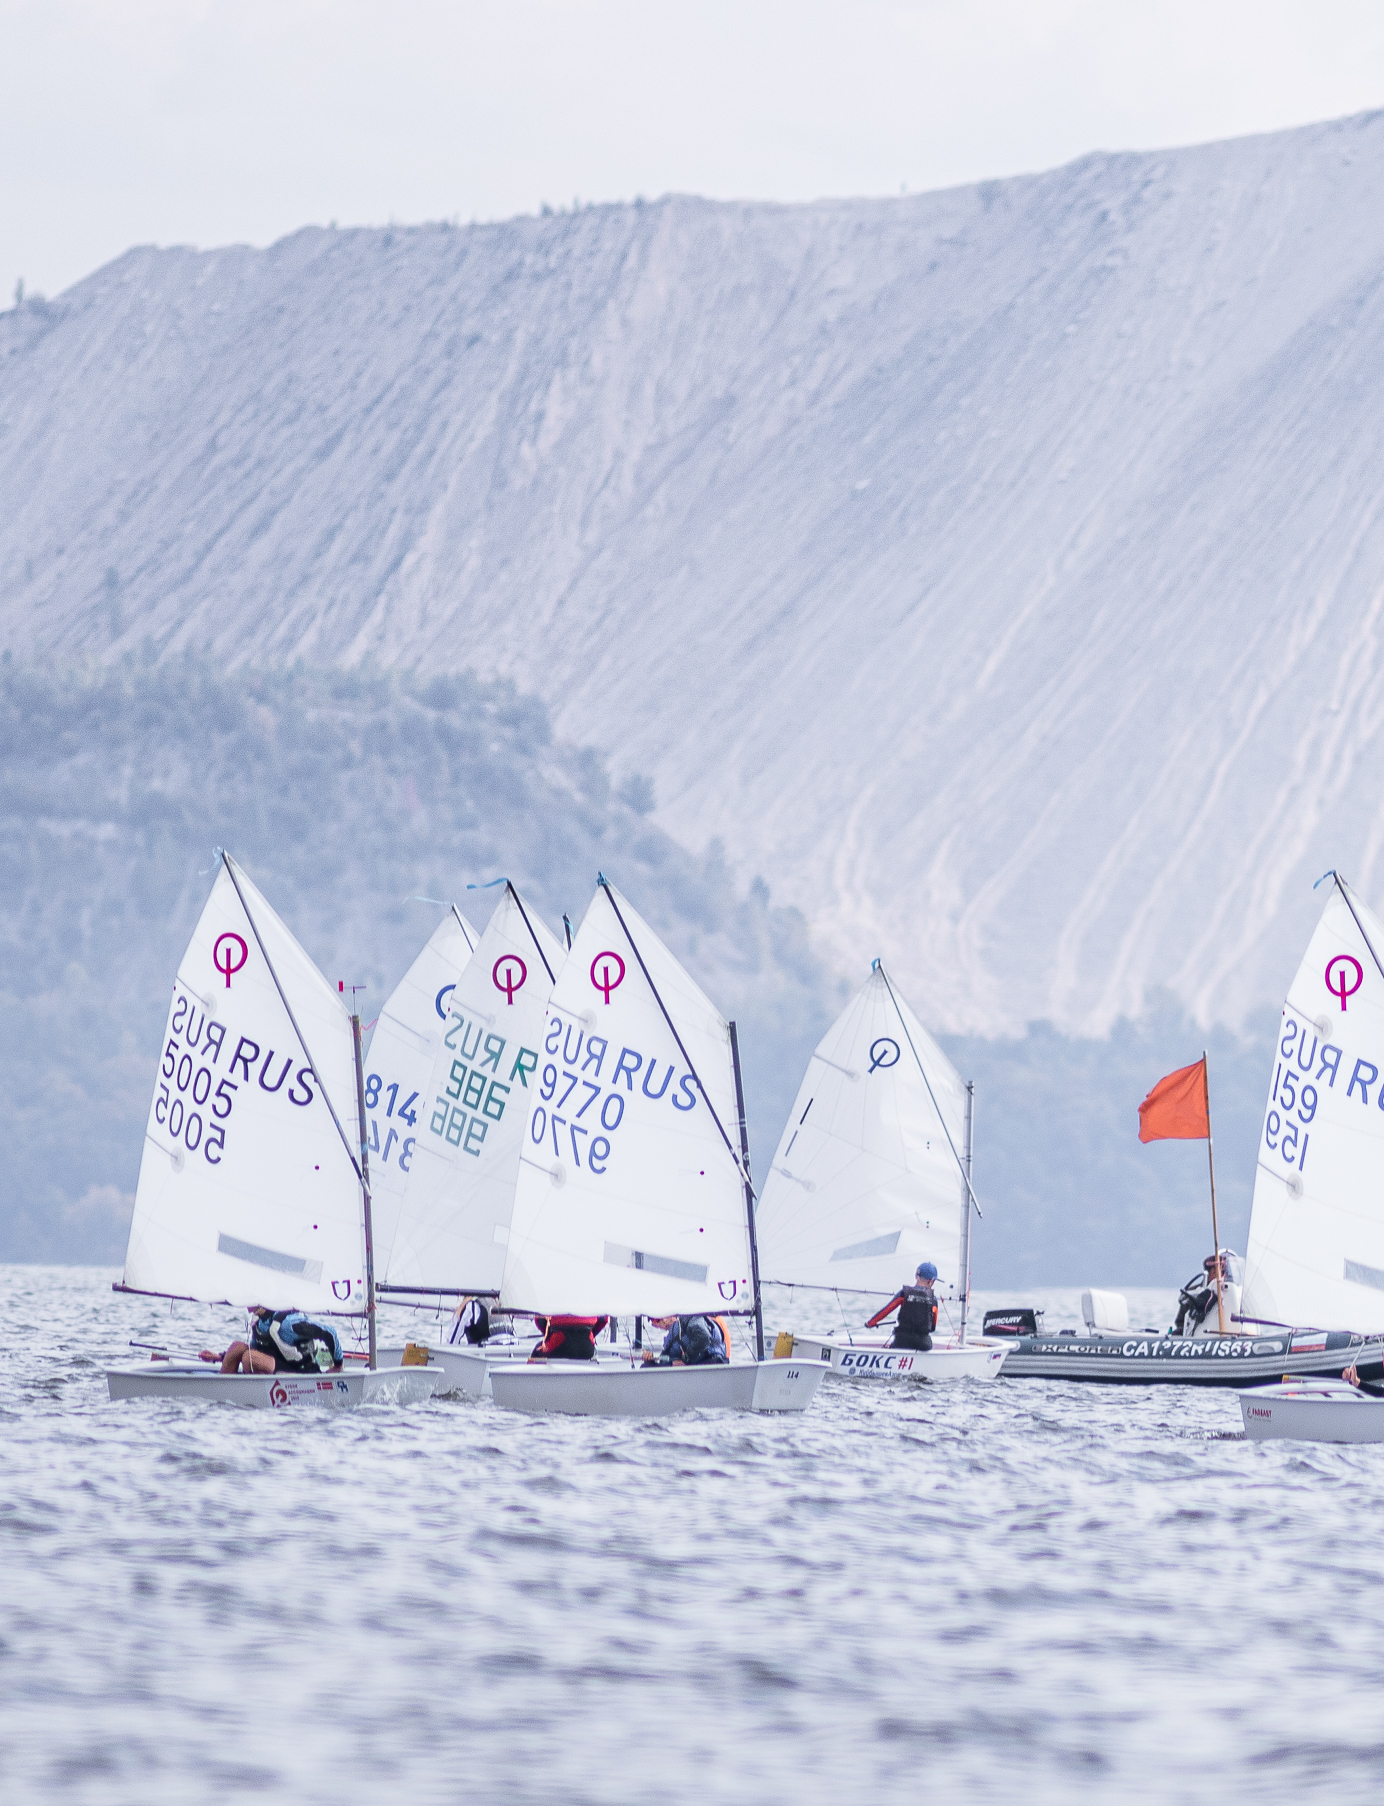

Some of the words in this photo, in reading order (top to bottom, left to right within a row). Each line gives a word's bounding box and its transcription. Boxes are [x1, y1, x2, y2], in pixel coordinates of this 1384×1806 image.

[162, 1038, 239, 1119] 5005
[228, 1036, 318, 1106] RUS
[365, 1074, 420, 1127] 814
[446, 1059, 511, 1121] 986
[539, 1063, 625, 1131] 9770
[612, 1047, 700, 1111] RUS
[1272, 1062, 1318, 1124] 159
[985, 1315, 1022, 1329] MERCURY
[841, 1353, 896, 1369] БОКС
[898, 1357, 914, 1370] #1
